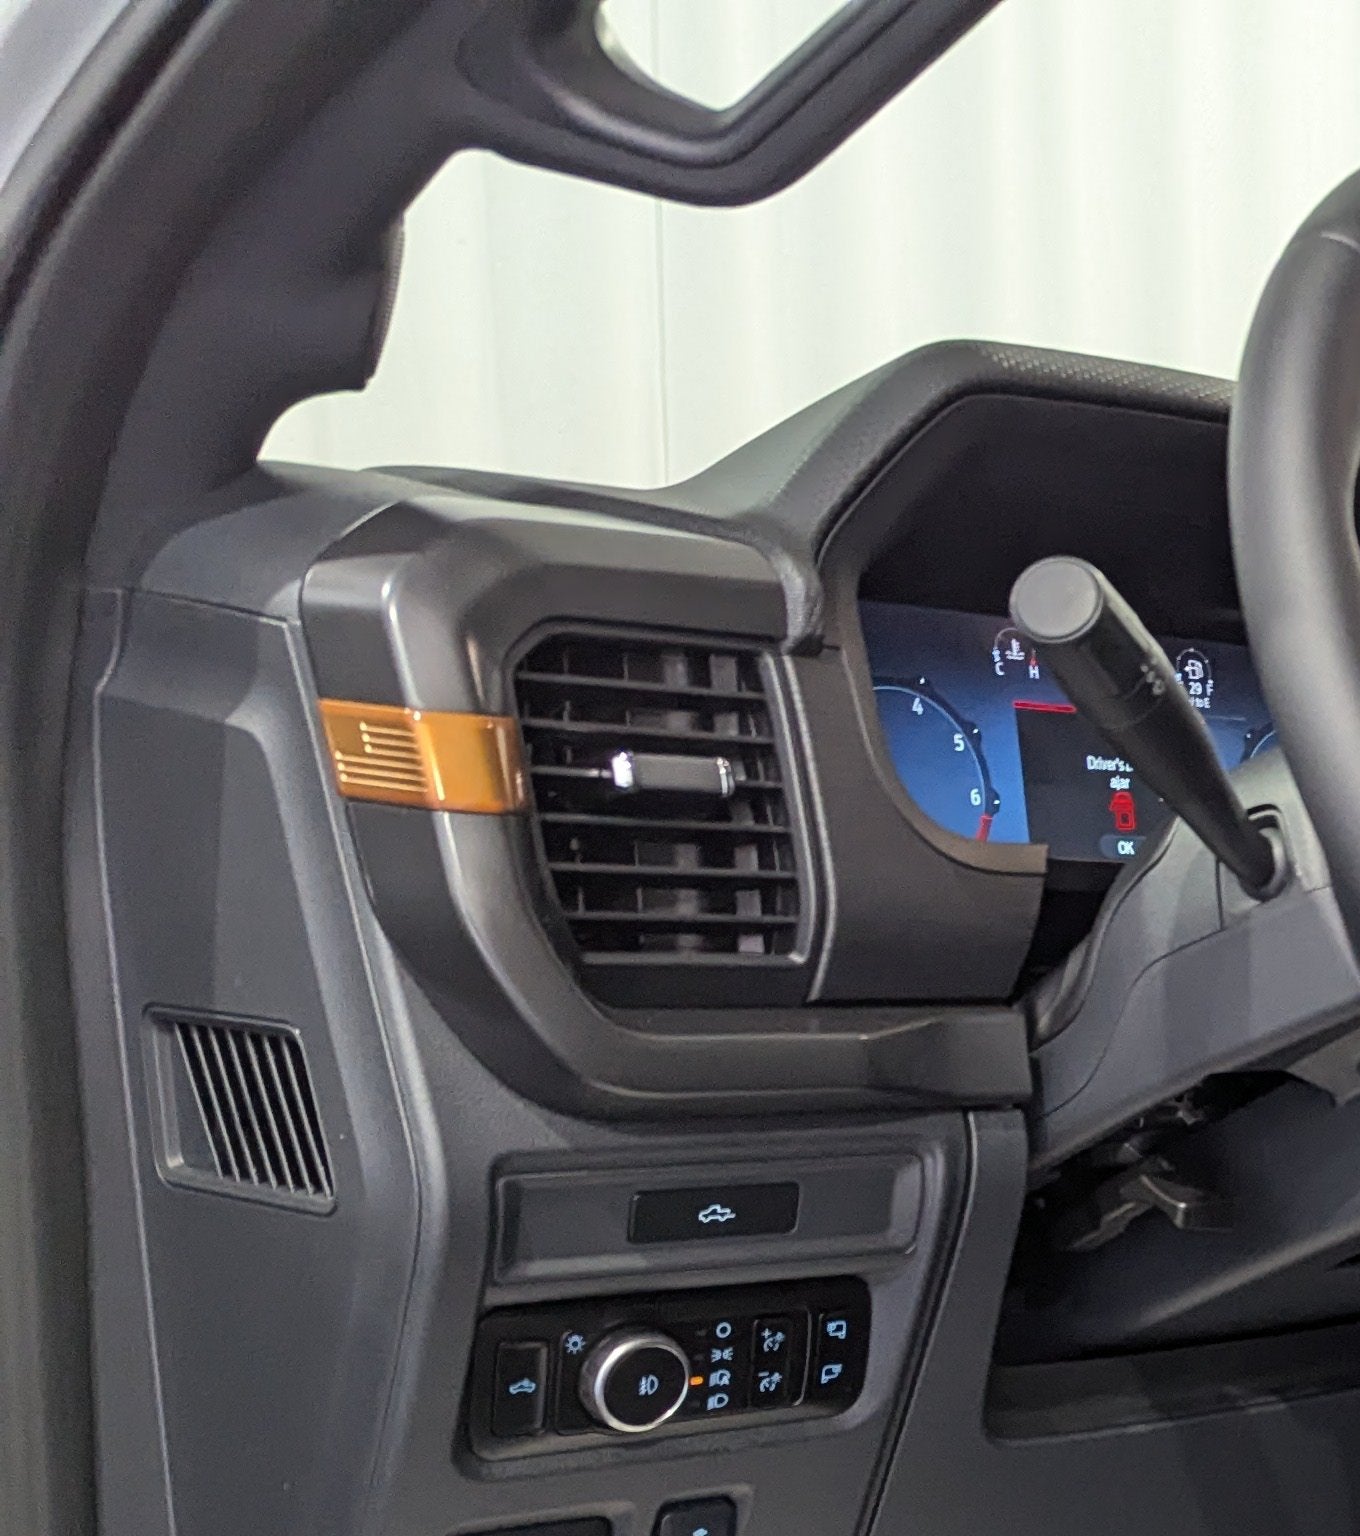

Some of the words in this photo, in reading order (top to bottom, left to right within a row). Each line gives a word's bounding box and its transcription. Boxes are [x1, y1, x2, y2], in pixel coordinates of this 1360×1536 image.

[912, 697, 924, 715] 4
[953, 733, 965, 751] 5
[970, 788, 981, 806] 6
[1117, 840, 1136, 855] OK
